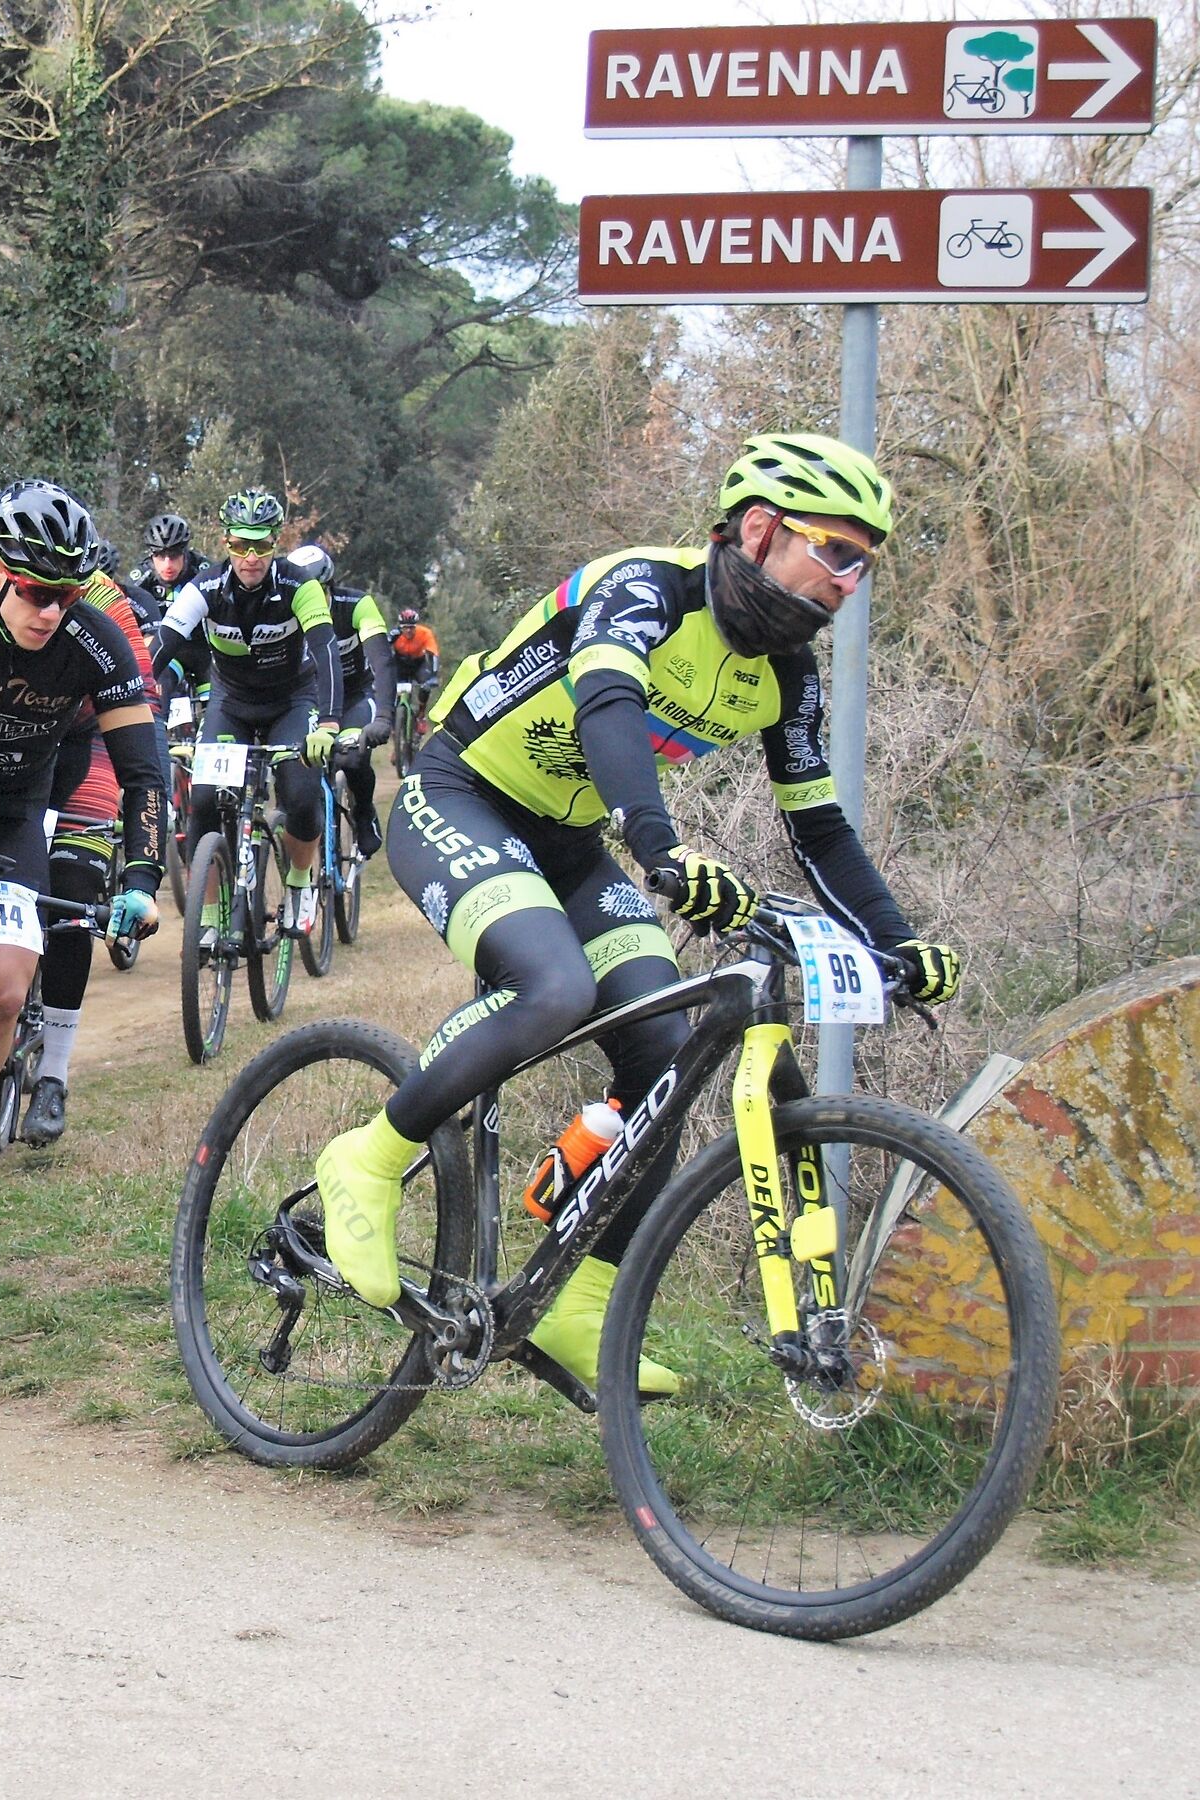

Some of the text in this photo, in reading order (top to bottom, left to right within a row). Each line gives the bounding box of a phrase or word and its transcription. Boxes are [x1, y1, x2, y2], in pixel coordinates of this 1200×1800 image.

[606, 49, 908, 99] RAVENNA
[599, 216, 902, 265] RAVENNA
[79, 629, 116, 672] ITALIANA
[647, 682, 667, 708] EKA
[660, 701, 709, 733] RIDERS
[706, 722, 740, 741] TEAM
[213, 758, 230, 774] 41
[403, 773, 474, 855] FOCUS
[783, 783, 834, 802] DEKA
[140, 789, 159, 861] Sambi Team
[587, 933, 641, 967] DEKA
[827, 953, 862, 994] 96
[442, 1000, 491, 1043] RIDERS
[419, 1032, 447, 1072] TEAM
[556, 1069, 677, 1245] SPEED
[318, 1156, 376, 1243] GIRO
[750, 1162, 783, 1259] DEKA
[650, 1527, 794, 1618] SCHWALBE
